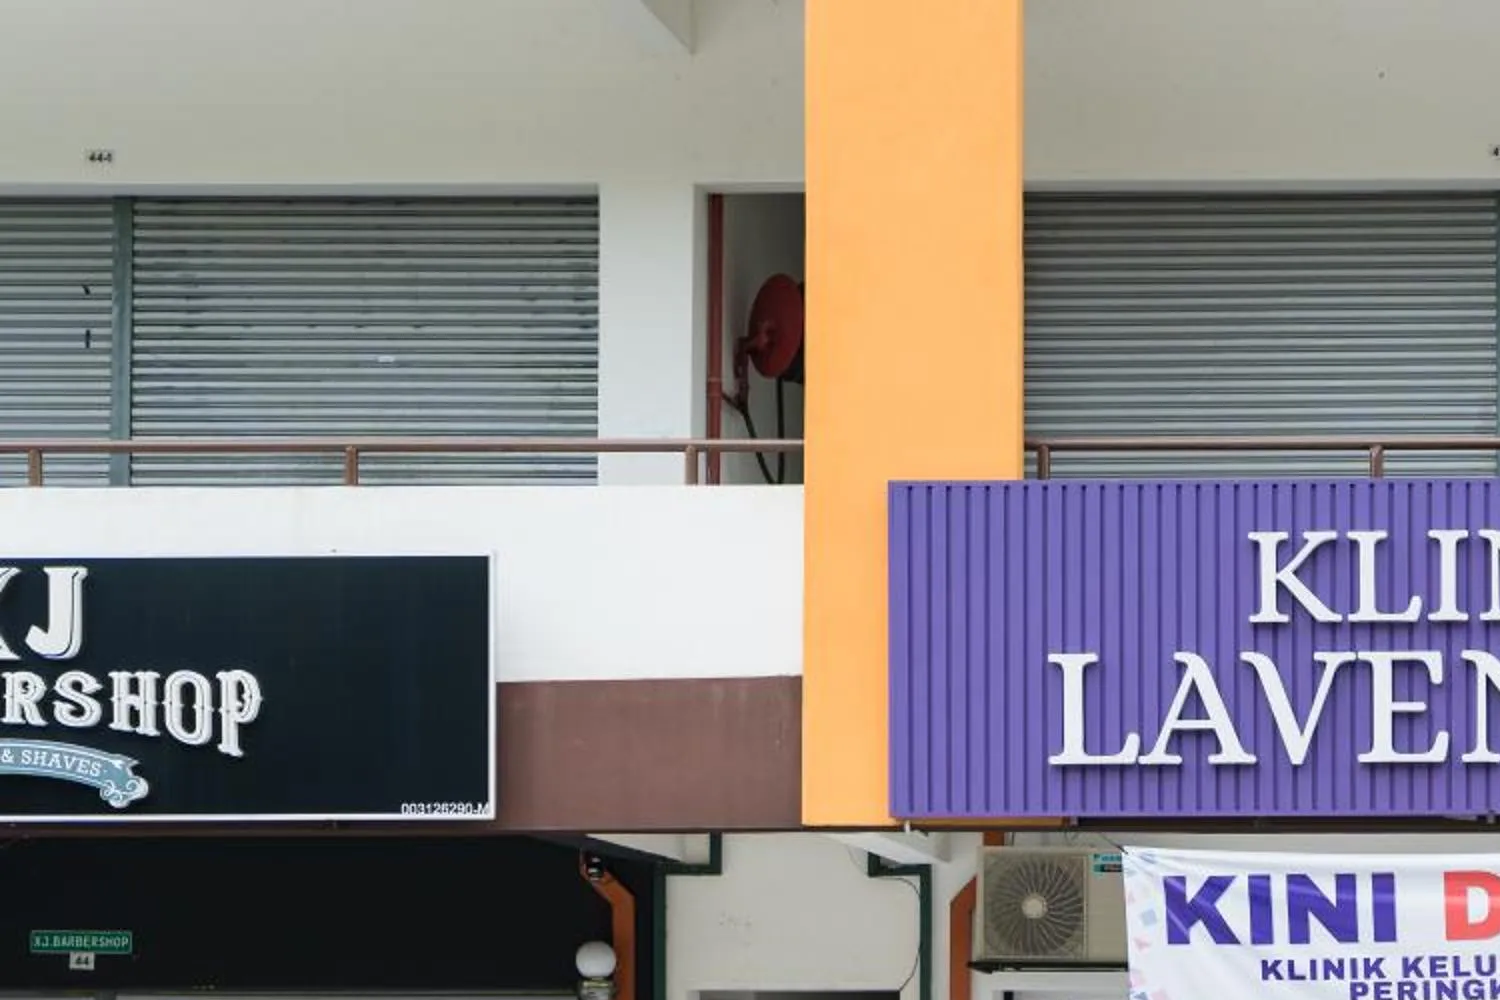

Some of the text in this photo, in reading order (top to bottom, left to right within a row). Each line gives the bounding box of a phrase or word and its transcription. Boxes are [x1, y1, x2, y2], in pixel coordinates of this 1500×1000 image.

[0, 566, 88, 660] J
[20, 749, 102, 777] SHAVES
[1163, 872, 1397, 945] KINI
[1261, 957, 1386, 981] KLINIK
